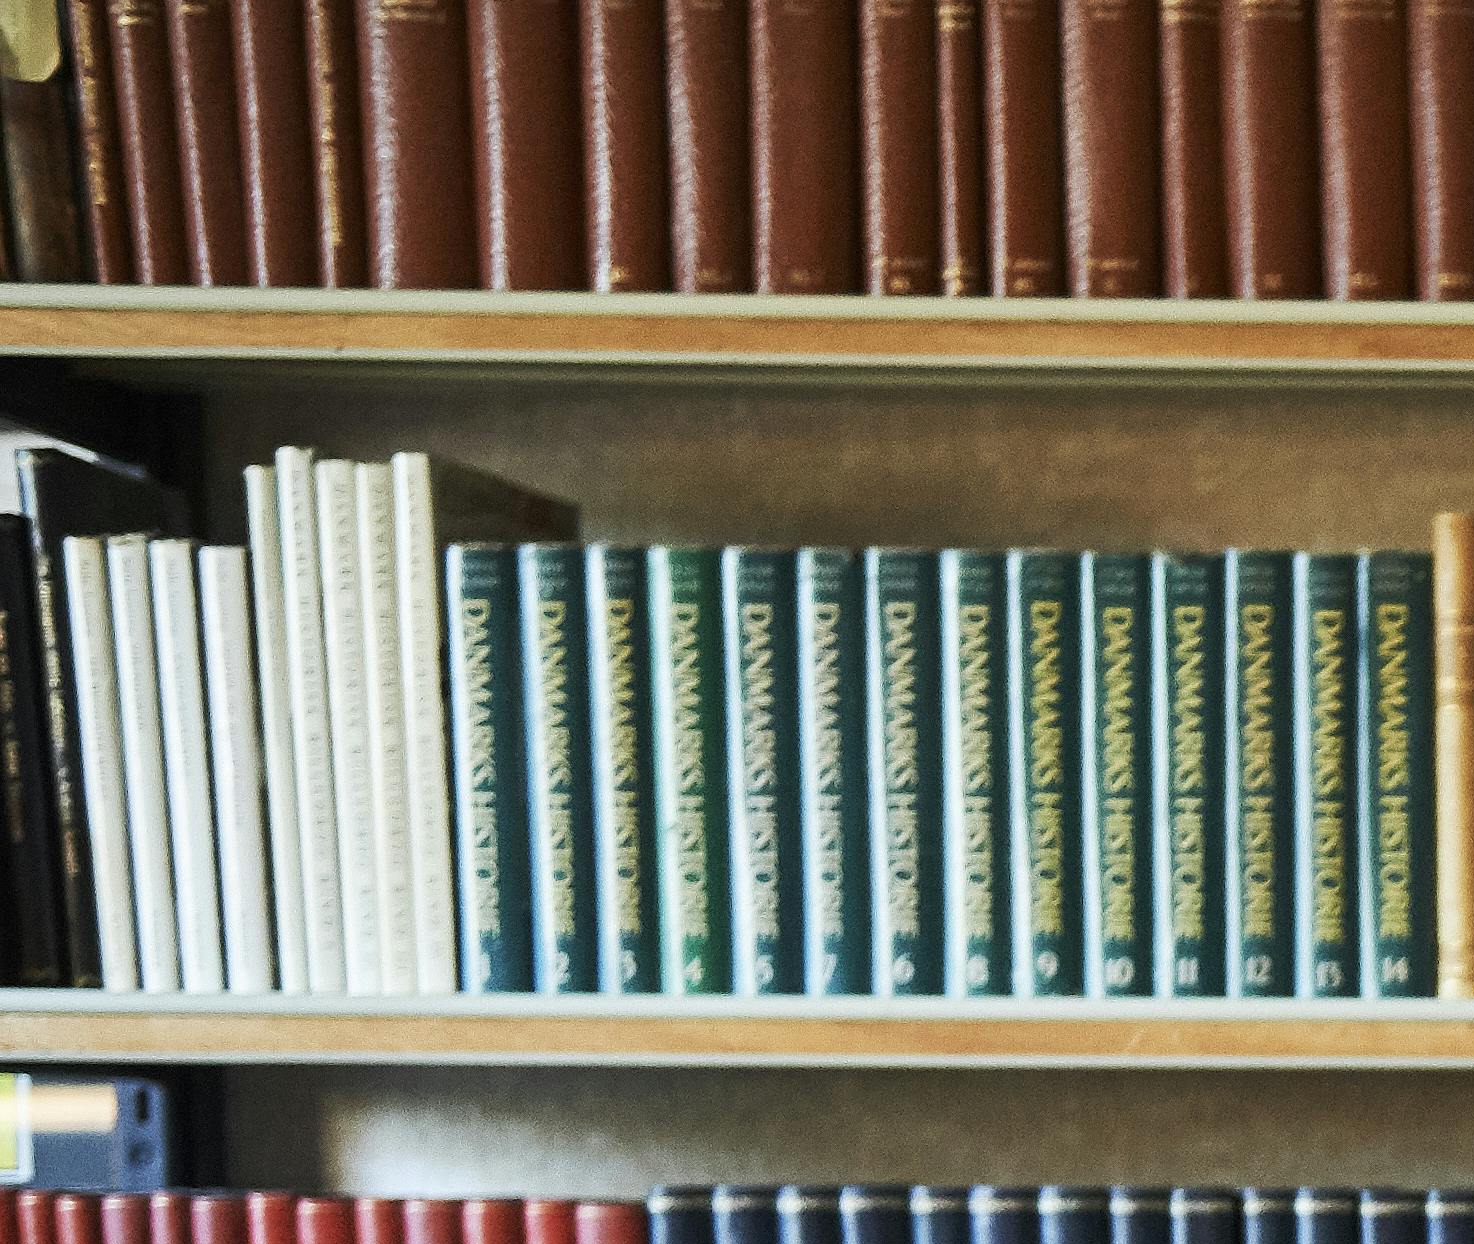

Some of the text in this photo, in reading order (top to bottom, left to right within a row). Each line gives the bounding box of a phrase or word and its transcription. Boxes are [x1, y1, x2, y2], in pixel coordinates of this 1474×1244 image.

[462, 599, 500, 937] DANMARKS HISTORIE
[540, 600, 575, 937] DANMARKS HISTORIE
[609, 598, 641, 935] DANMARKS HISTORIE
[672, 603, 709, 937] DANMARKS HISTORIE
[743, 603, 781, 937] DANMARKS HISTORIE
[814, 603, 844, 937] DANMARKS HISTORIE
[885, 601, 921, 937] DANMARKS HISTORIE
[960, 604, 993, 937] DANMARKS HISTORIE
[1031, 600, 1063, 935] DANMARKS HISTORIE
[1104, 605, 1134, 939] DANMARKS HISTORIE
[1173, 604, 1205, 939] DANMARKS HISTORIE
[1243, 604, 1274, 939] DANMARKS HISTORIE
[1313, 609, 1344, 944] DANMARKS HISTORIE
[1376, 603, 1411, 937] DANMARKS HISTORIE
